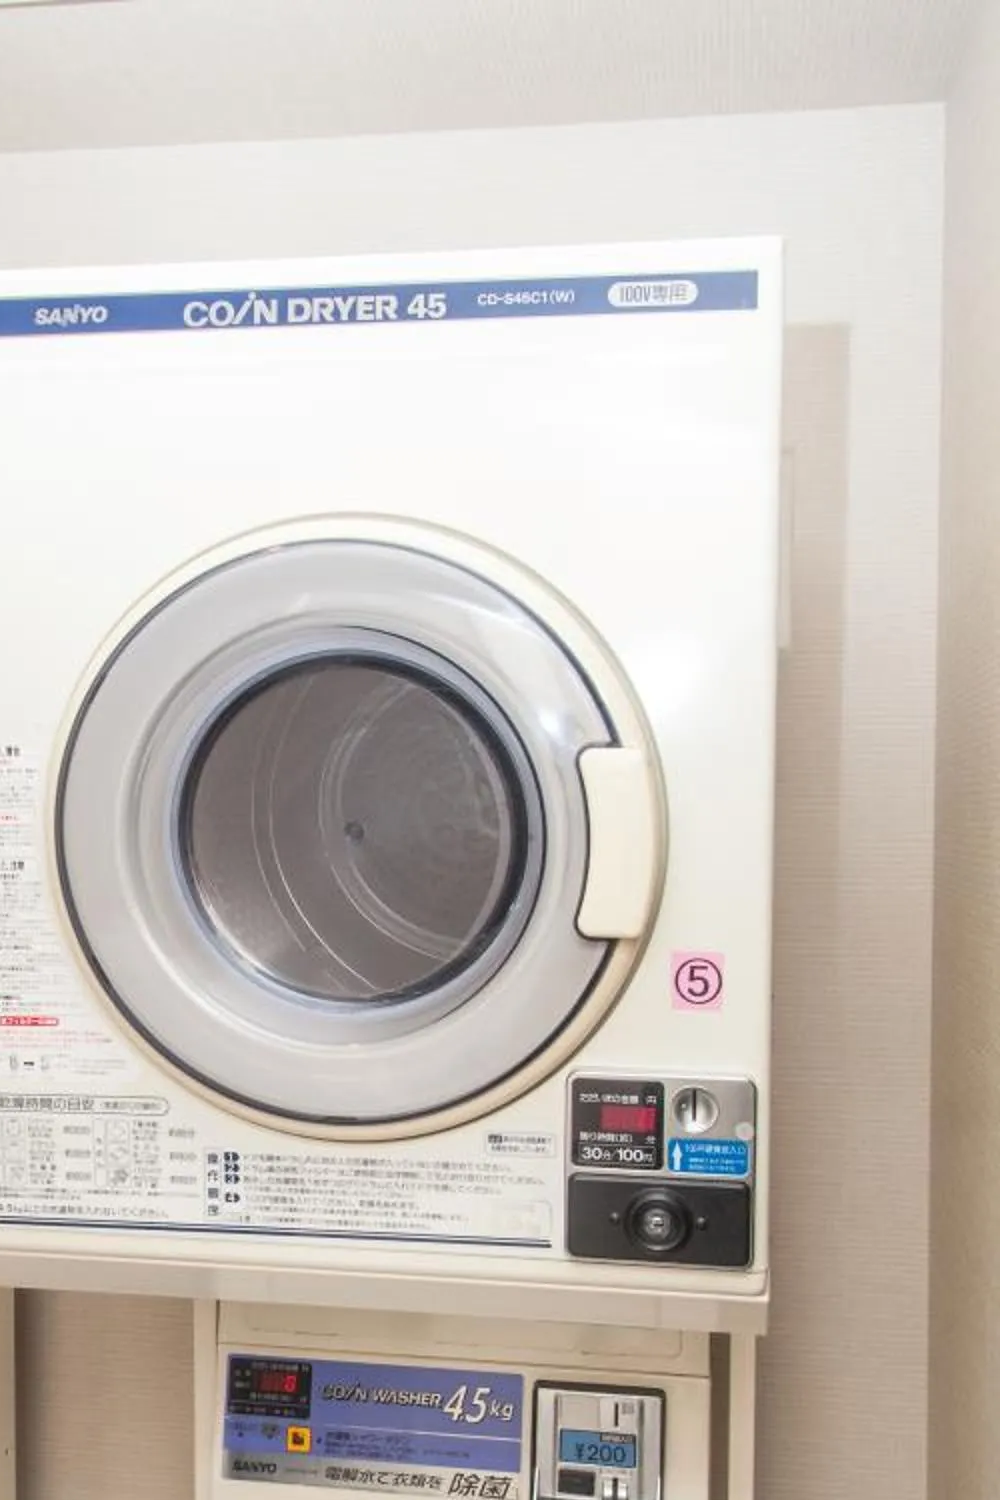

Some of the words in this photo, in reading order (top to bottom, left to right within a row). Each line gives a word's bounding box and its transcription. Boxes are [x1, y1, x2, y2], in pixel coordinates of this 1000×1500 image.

[34, 304, 108, 326] SANYO
[287, 295, 398, 323] DRYER
[407, 293, 447, 321] 45
[372, 1387, 443, 1410] WASHER
[575, 1442, 626, 1464] ¥200
[324, 1465, 441, 1490] 電解水で衣類を
[448, 1470, 515, 1500] 除菌
